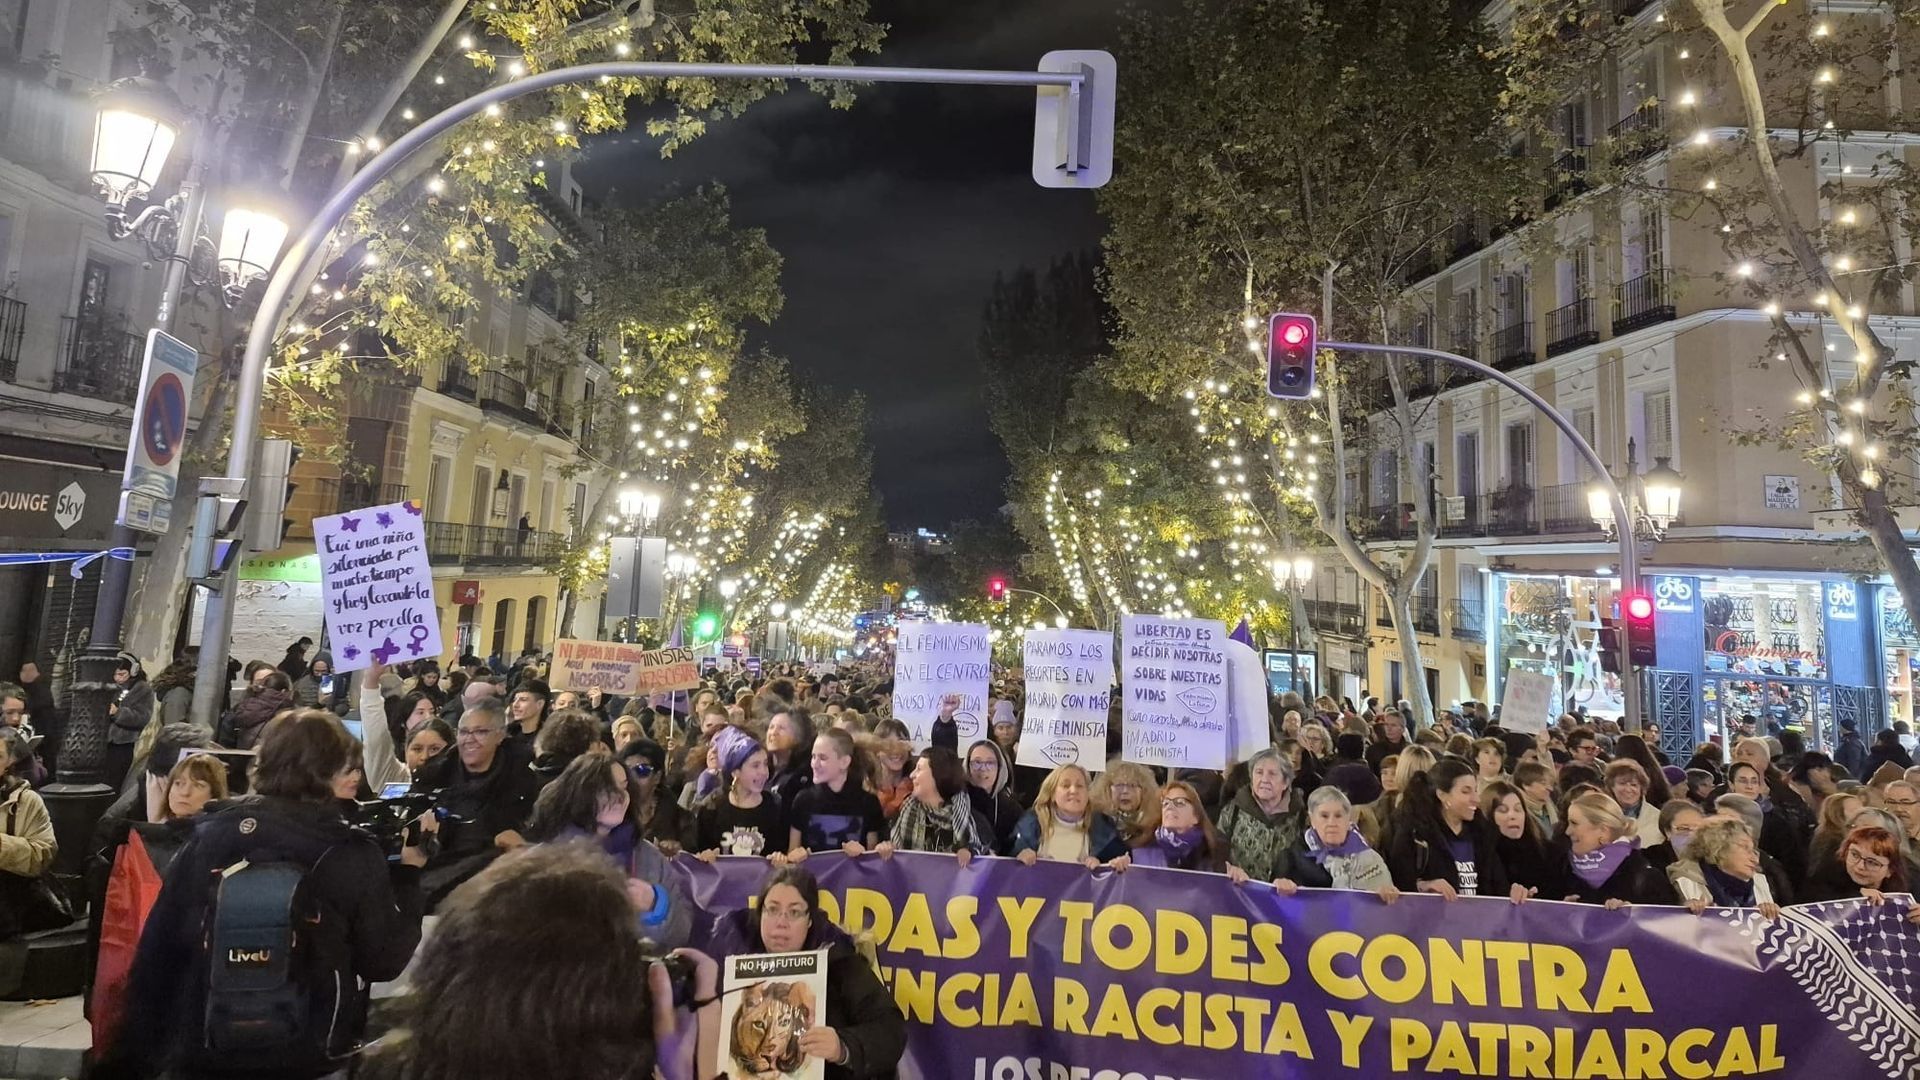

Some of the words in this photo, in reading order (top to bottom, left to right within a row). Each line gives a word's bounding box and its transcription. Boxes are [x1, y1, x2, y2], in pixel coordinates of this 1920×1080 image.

[57, 495, 83, 521] Sky
[355, 538, 380, 549] una
[383, 531, 415, 545] niña
[240, 560, 308, 569] SIGNAS
[328, 549, 394, 575] silenciada
[397, 545, 420, 561] por
[332, 571, 370, 590] mucho
[370, 566, 415, 583] tiempo
[338, 622, 363, 635] voz
[368, 617, 394, 639] por
[1136, 624, 1191, 639] LIBERTAD
[1197, 628, 1211, 640] ES
[898, 634, 912, 650] EL
[918, 634, 987, 652] FEMINISMO
[1026, 641, 1072, 656] PARAMOS
[1080, 643, 1102, 658] LOS
[1132, 646, 1170, 659] DECIDIR
[1174, 649, 1223, 663] NOSOTRAS
[897, 663, 912, 680] EN
[920, 663, 932, 680] EL
[1025, 665, 1069, 681] RECORTES
[1076, 668, 1094, 683] EN
[1135, 667, 1166, 680] SOBRE
[1171, 671, 1222, 685] NUESTRAS
[894, 694, 924, 711] AYUSO
[927, 694, 934, 709] Y
[1027, 691, 1057, 708] MADRID
[1061, 694, 1083, 709] CON
[1135, 688, 1166, 701] VIDAS
[1049, 720, 1105, 737] FEMINISTA
[229, 949, 271, 962] LiveU
[997, 896, 1045, 958] Y
[1059, 900, 1291, 985] TODES
[1308, 931, 1654, 1013] CONTRA
[740, 961, 754, 971] NO
[776, 957, 814, 968] FUTURO
[1053, 976, 1314, 1060] RACISTA
[1325, 1008, 1375, 1069] Y
[1390, 1017, 1785, 1079] PATRIARCAL
